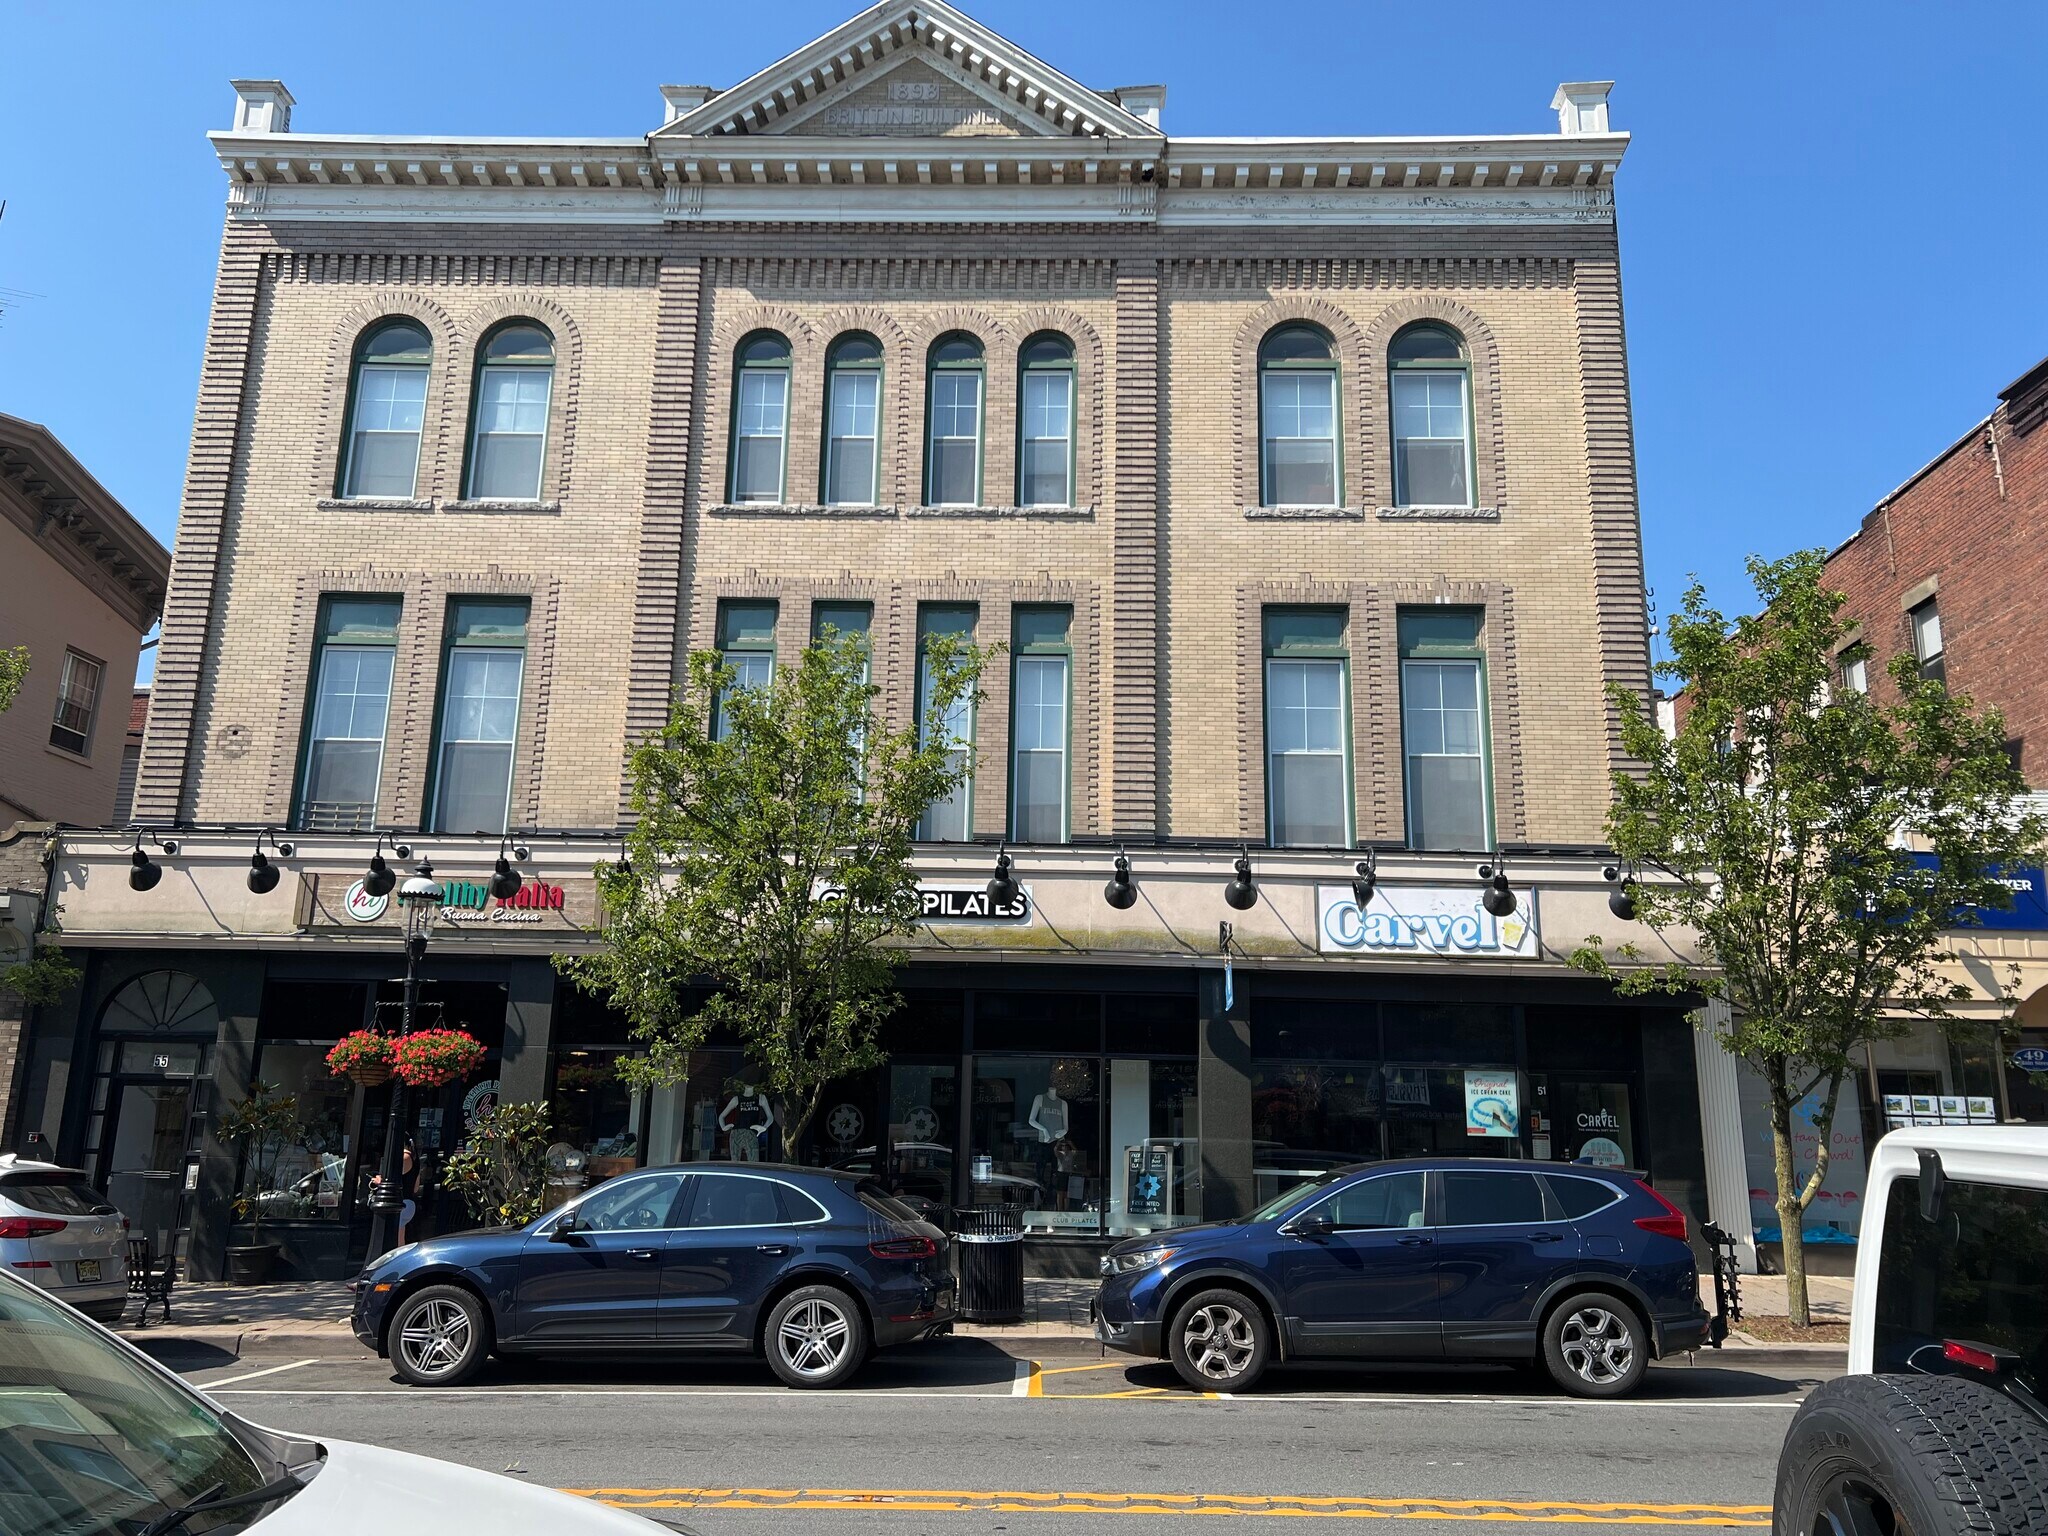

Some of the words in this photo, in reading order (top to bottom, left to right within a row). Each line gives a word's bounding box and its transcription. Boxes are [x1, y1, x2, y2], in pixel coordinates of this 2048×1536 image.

[911, 108, 998, 126] BUILDING
[440, 906, 487, 921] Buona
[490, 907, 541, 921] Cucina
[1325, 900, 1498, 950] Carvel
[154, 1055, 168, 1066] 55
[2023, 1050, 2044, 1061] 49
[1537, 1086, 1546, 1096] 51
[1577, 1112, 1620, 1128] CARVEL
[1833, 1132, 1861, 1144] Out
[1804, 1148, 1854, 1160] Crwd!
